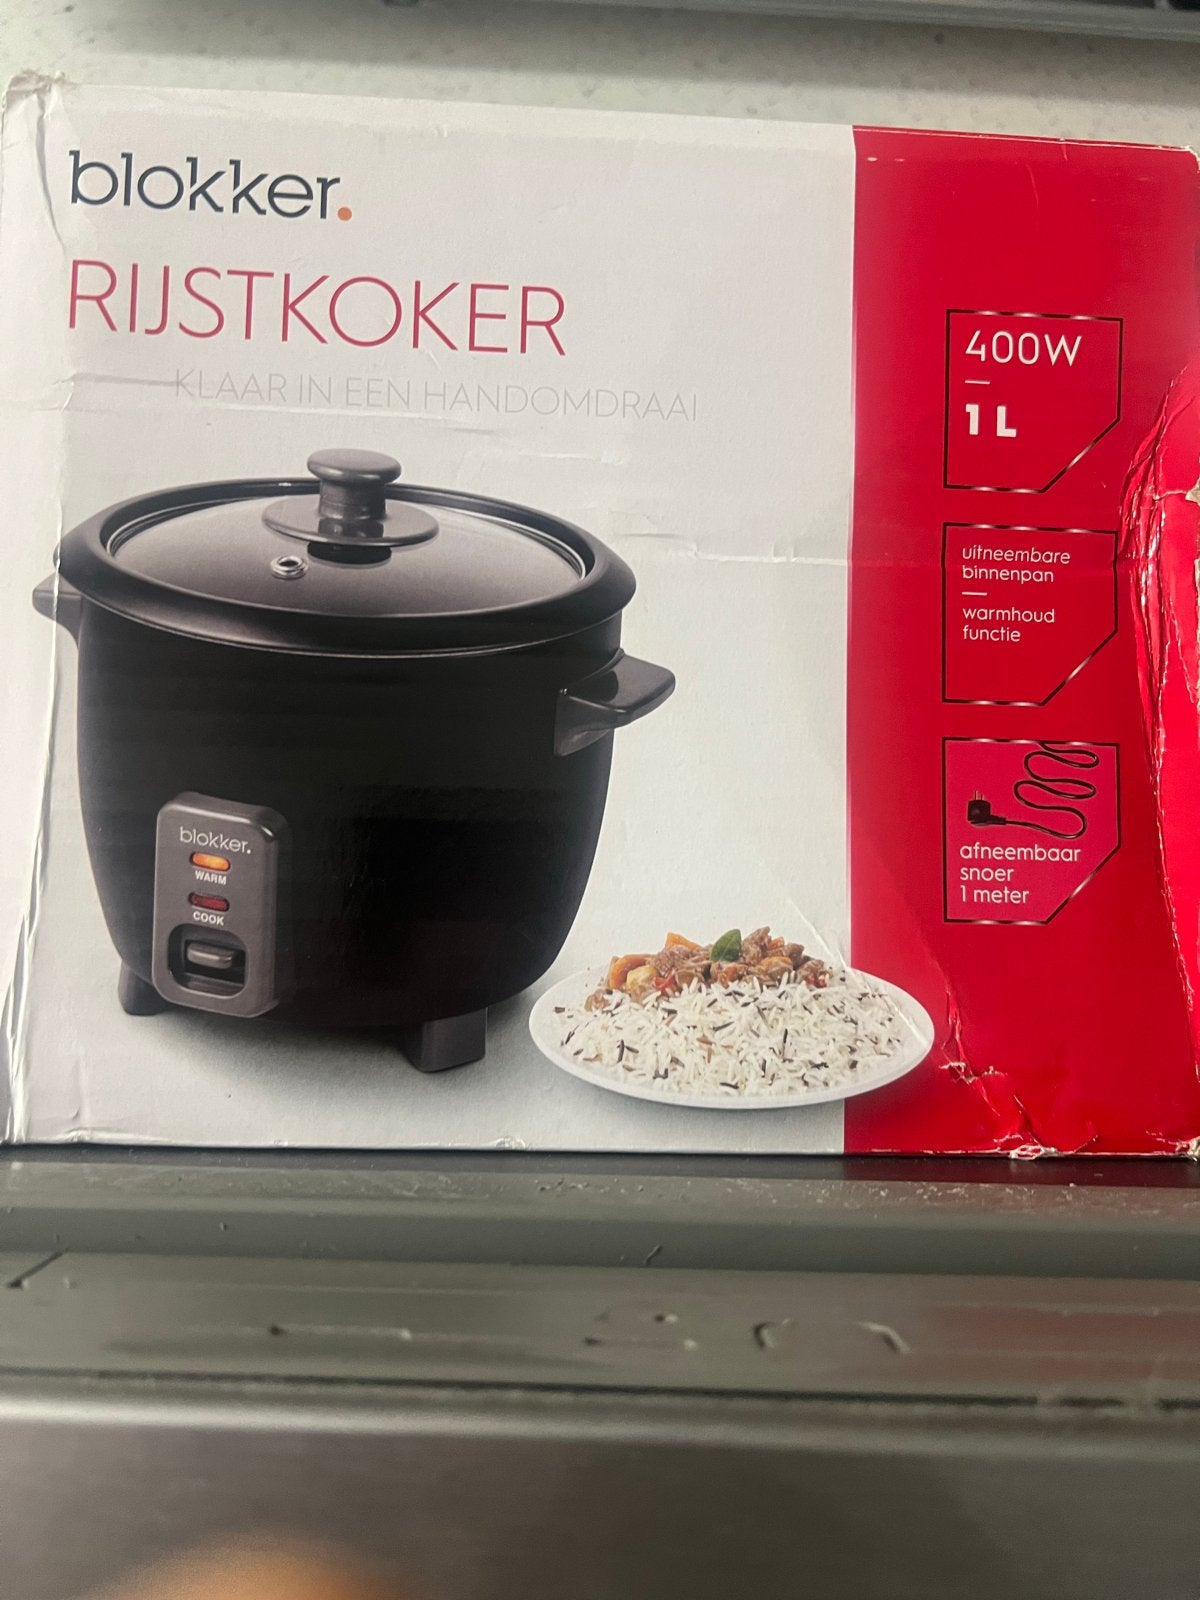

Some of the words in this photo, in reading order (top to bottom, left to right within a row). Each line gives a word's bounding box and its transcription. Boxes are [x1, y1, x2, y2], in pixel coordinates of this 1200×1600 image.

[69, 150, 353, 221] blokker.
[68, 259, 566, 356] RIJSTKOKER
[965, 330, 1082, 366] 400W
[175, 368, 287, 404] KLAAR
[300, 374, 332, 405] IN
[346, 376, 411, 409] EEN
[425, 380, 697, 422] HANDOMDRAAI
[965, 404, 979, 435] 1
[996, 405, 1017, 437] L
[962, 544, 1071, 565] uitneembare
[962, 564, 1054, 584] binnenpan
[962, 606, 1055, 624] warmhoud
[962, 624, 1021, 643] functie
[180, 826, 251, 854] blokker.
[959, 842, 1081, 862] afneembaar
[195, 870, 227, 885] WARM
[959, 866, 1015, 882] snoer
[960, 885, 967, 903] 1
[973, 886, 1030, 904] meter
[193, 911, 225, 926] COOK
